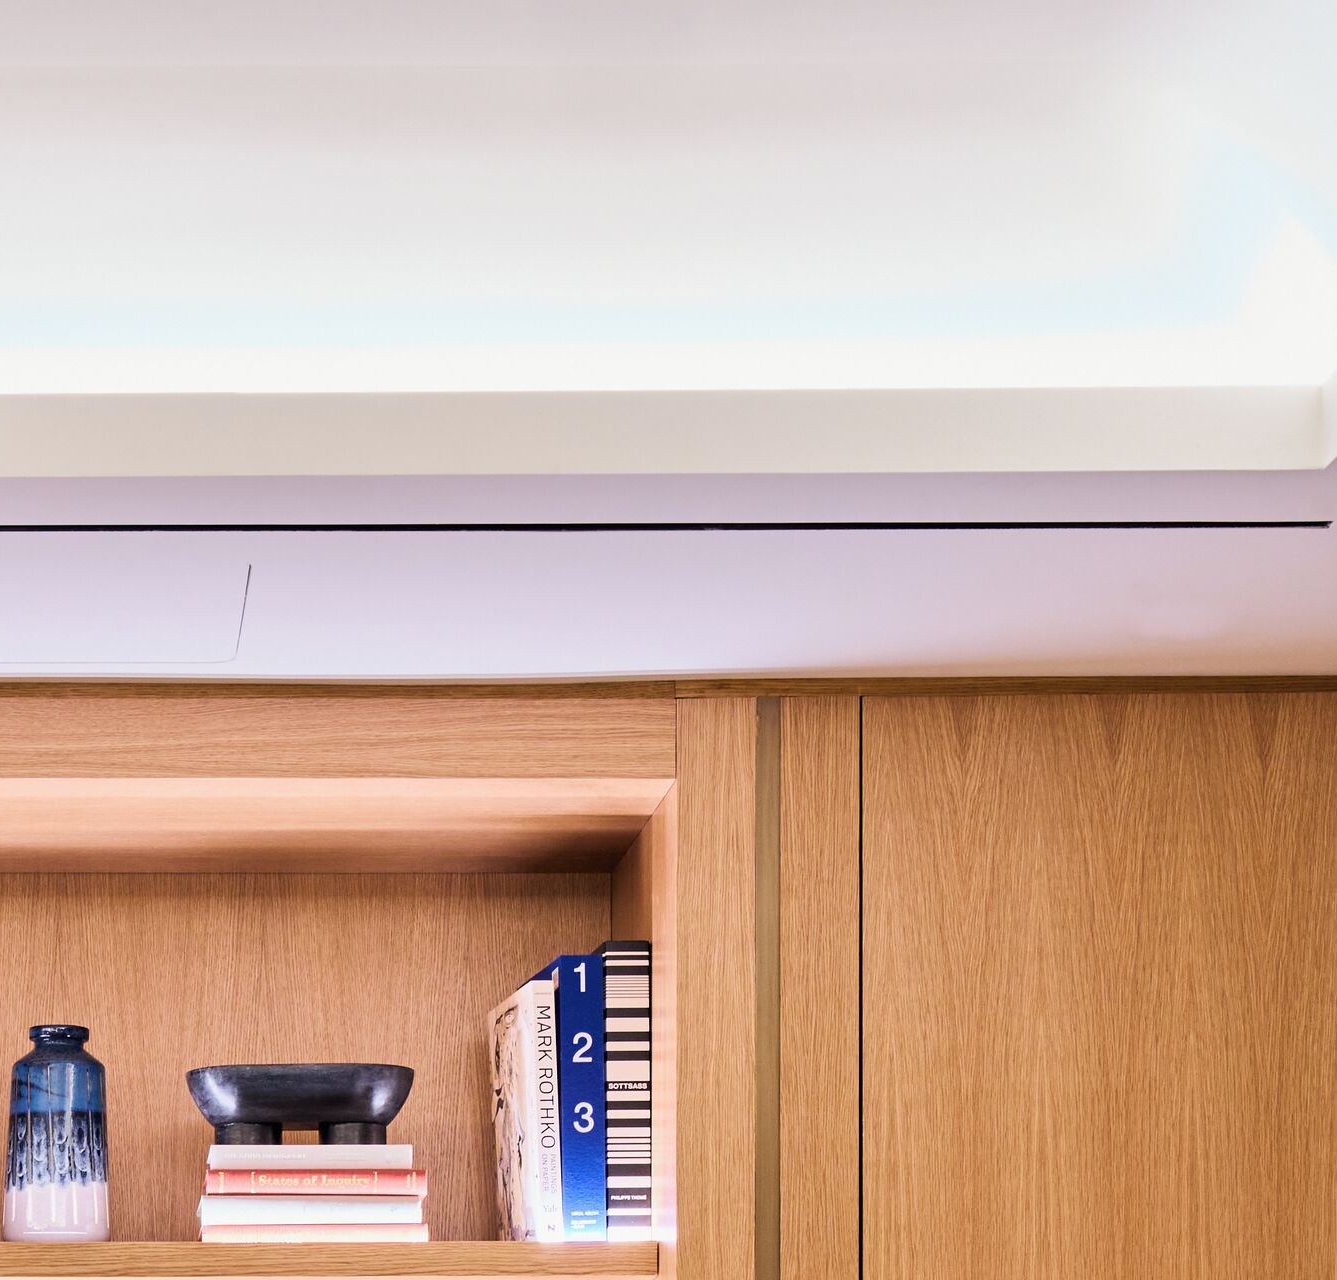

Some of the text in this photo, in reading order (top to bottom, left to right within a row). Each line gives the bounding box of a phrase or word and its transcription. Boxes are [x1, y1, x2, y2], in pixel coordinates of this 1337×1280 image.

[573, 962, 586, 993] 1
[536, 1005, 553, 1061] MARK
[572, 1032, 593, 1062] 2
[608, 1082, 648, 1090] SOTTSASS
[538, 1067, 556, 1149] ROTHKO
[573, 1102, 595, 1133] 3
[542, 1154, 549, 1164] ON
[550, 1153, 558, 1194] PAINTINGS
[258, 1175, 371, 1188] States of Inquiry
